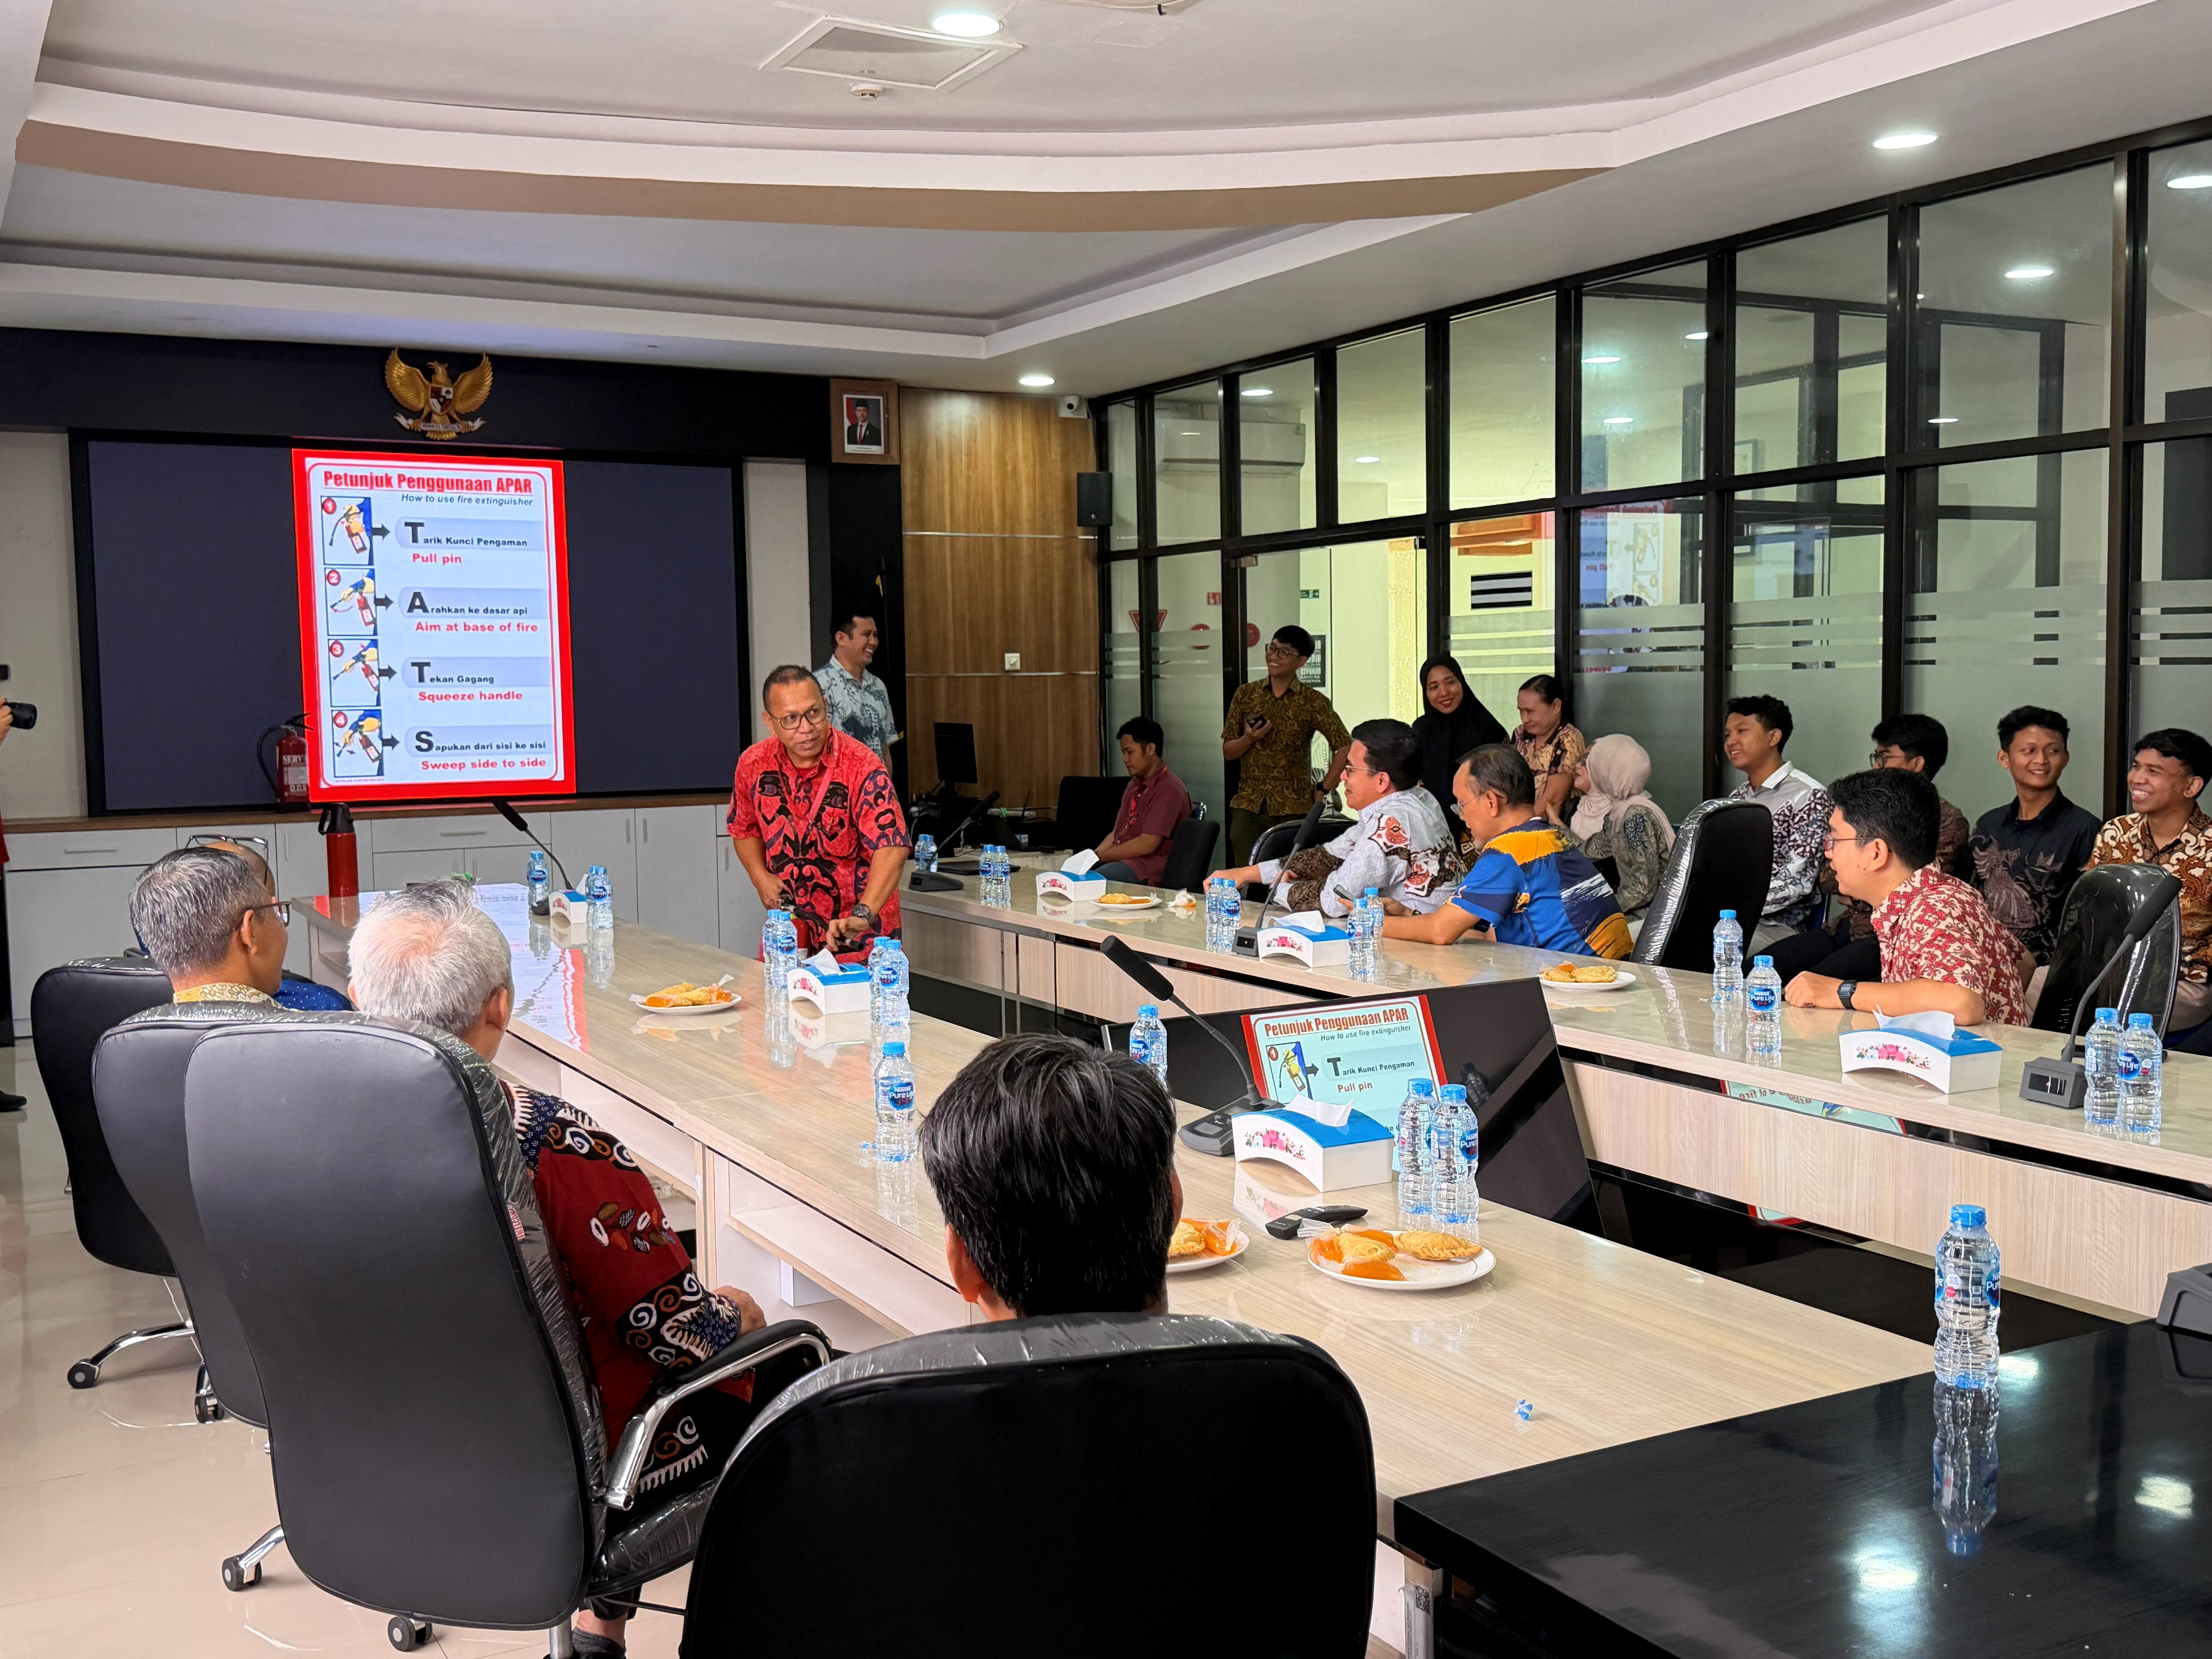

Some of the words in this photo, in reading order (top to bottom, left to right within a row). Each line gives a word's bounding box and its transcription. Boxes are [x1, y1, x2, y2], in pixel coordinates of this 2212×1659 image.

[324, 471, 393, 490] Petunjuk
[397, 474, 492, 493] Penggunaan
[496, 478, 532, 493] APAR
[401, 493, 423, 502] How
[457, 495, 473, 504] fire
[475, 496, 534, 506] extinguisher
[477, 538, 527, 547] Pengaman
[412, 553, 437, 563] Pull
[442, 554, 462, 566] pin
[513, 607, 528, 616] api
[415, 623, 441, 632] Aim
[446, 623, 459, 632] at
[463, 623, 496, 632] base
[499, 623, 512, 632] of
[516, 622, 538, 632] fire
[457, 675, 495, 684] Gagang
[418, 691, 475, 703] Squeeze
[479, 691, 523, 701] handle
[283, 755, 303, 763] SERV
[421, 760, 466, 772] Sweep
[471, 759, 498, 768] side
[503, 759, 515, 768] to
[520, 758, 546, 768] side
[1765, 994, 1775, 1003] Life
[1264, 1018, 1314, 1037] Petunjuk
[1314, 1011, 1382, 1032] Penggunaan
[1382, 1007, 1409, 1023] APAR
[1321, 1033, 1335, 1041] How
[1358, 1029, 1370, 1038] fire
[1371, 1025, 1411, 1037] extinguisher
[1138, 1048, 1149, 1056] Life
[1358, 1064, 1377, 1073] Kunci
[1379, 1060, 1415, 1072] Pengaman
[2126, 1061, 2140, 1071] Life
[1337, 1083, 1355, 1093] Pull
[1358, 1081, 1373, 1092] pin
[1461, 1140, 1475, 1149] Pure
[1987, 1281, 2000, 1291] Pur
